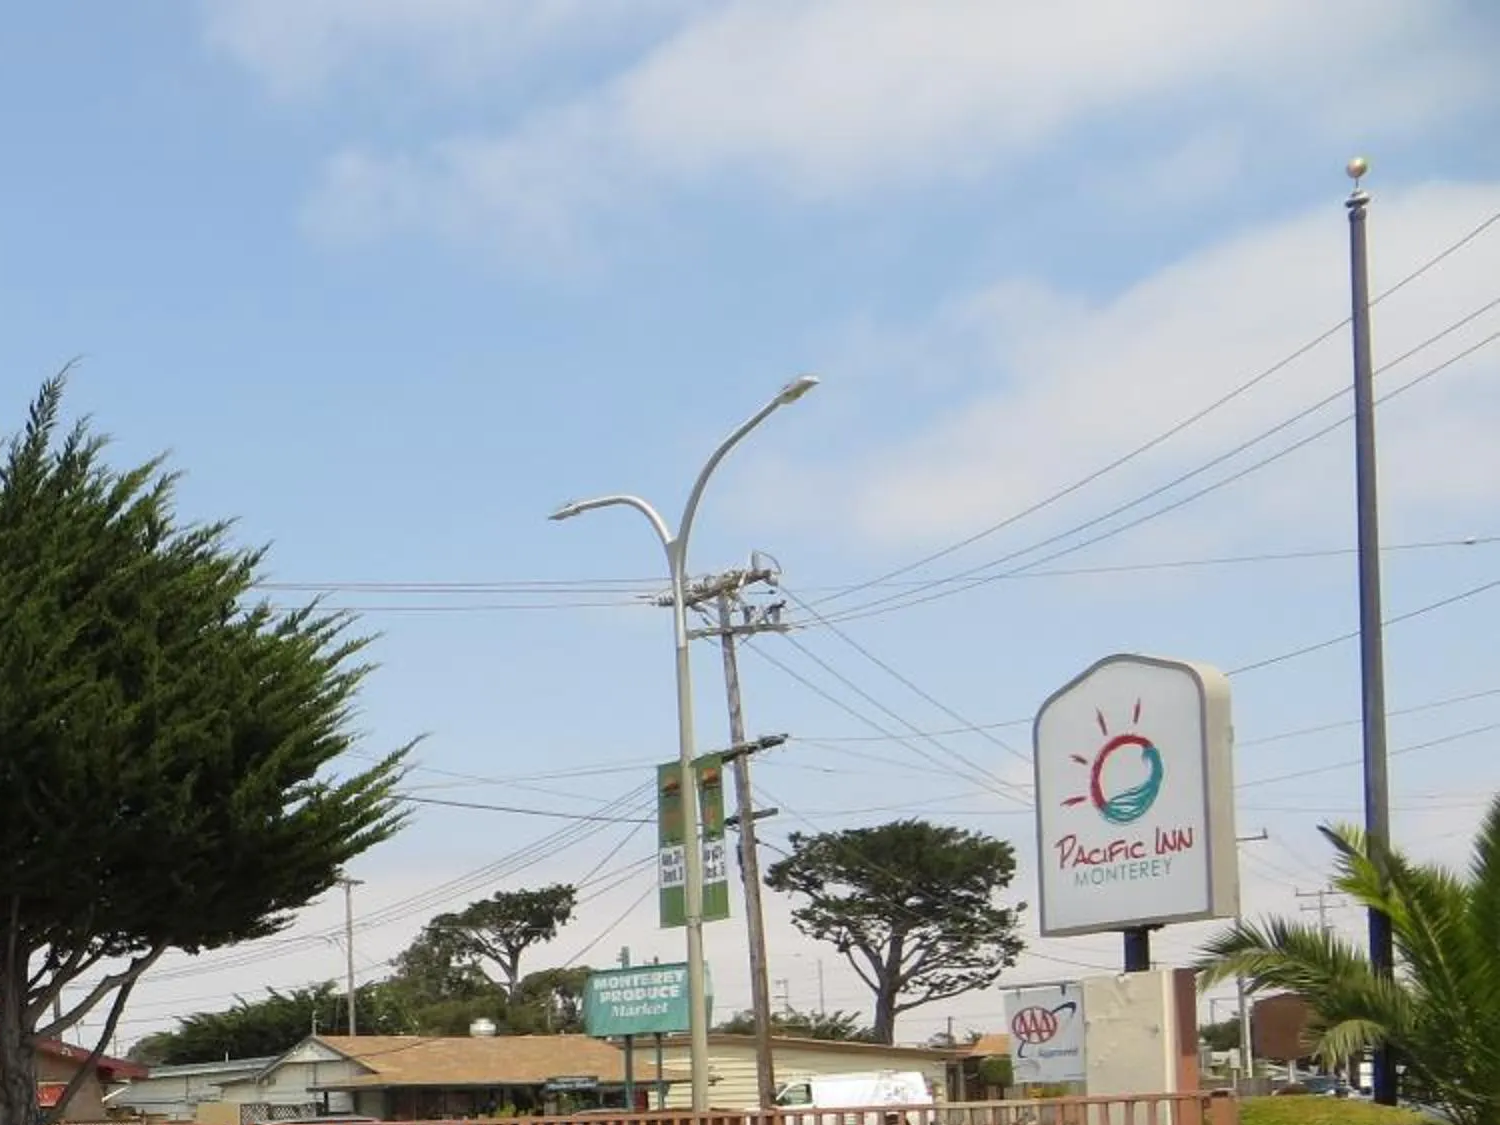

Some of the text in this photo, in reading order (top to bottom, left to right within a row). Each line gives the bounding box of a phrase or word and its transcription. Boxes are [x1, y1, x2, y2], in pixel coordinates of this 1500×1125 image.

[1054, 825, 1194, 869] PACIFIC INN
[1075, 857, 1172, 886] MONTEREY
[593, 969, 683, 990] MONTEREY
[600, 984, 680, 1004] PRODUCE
[611, 1001, 668, 1017] Market
[1015, 1008, 1055, 1041] AAA
